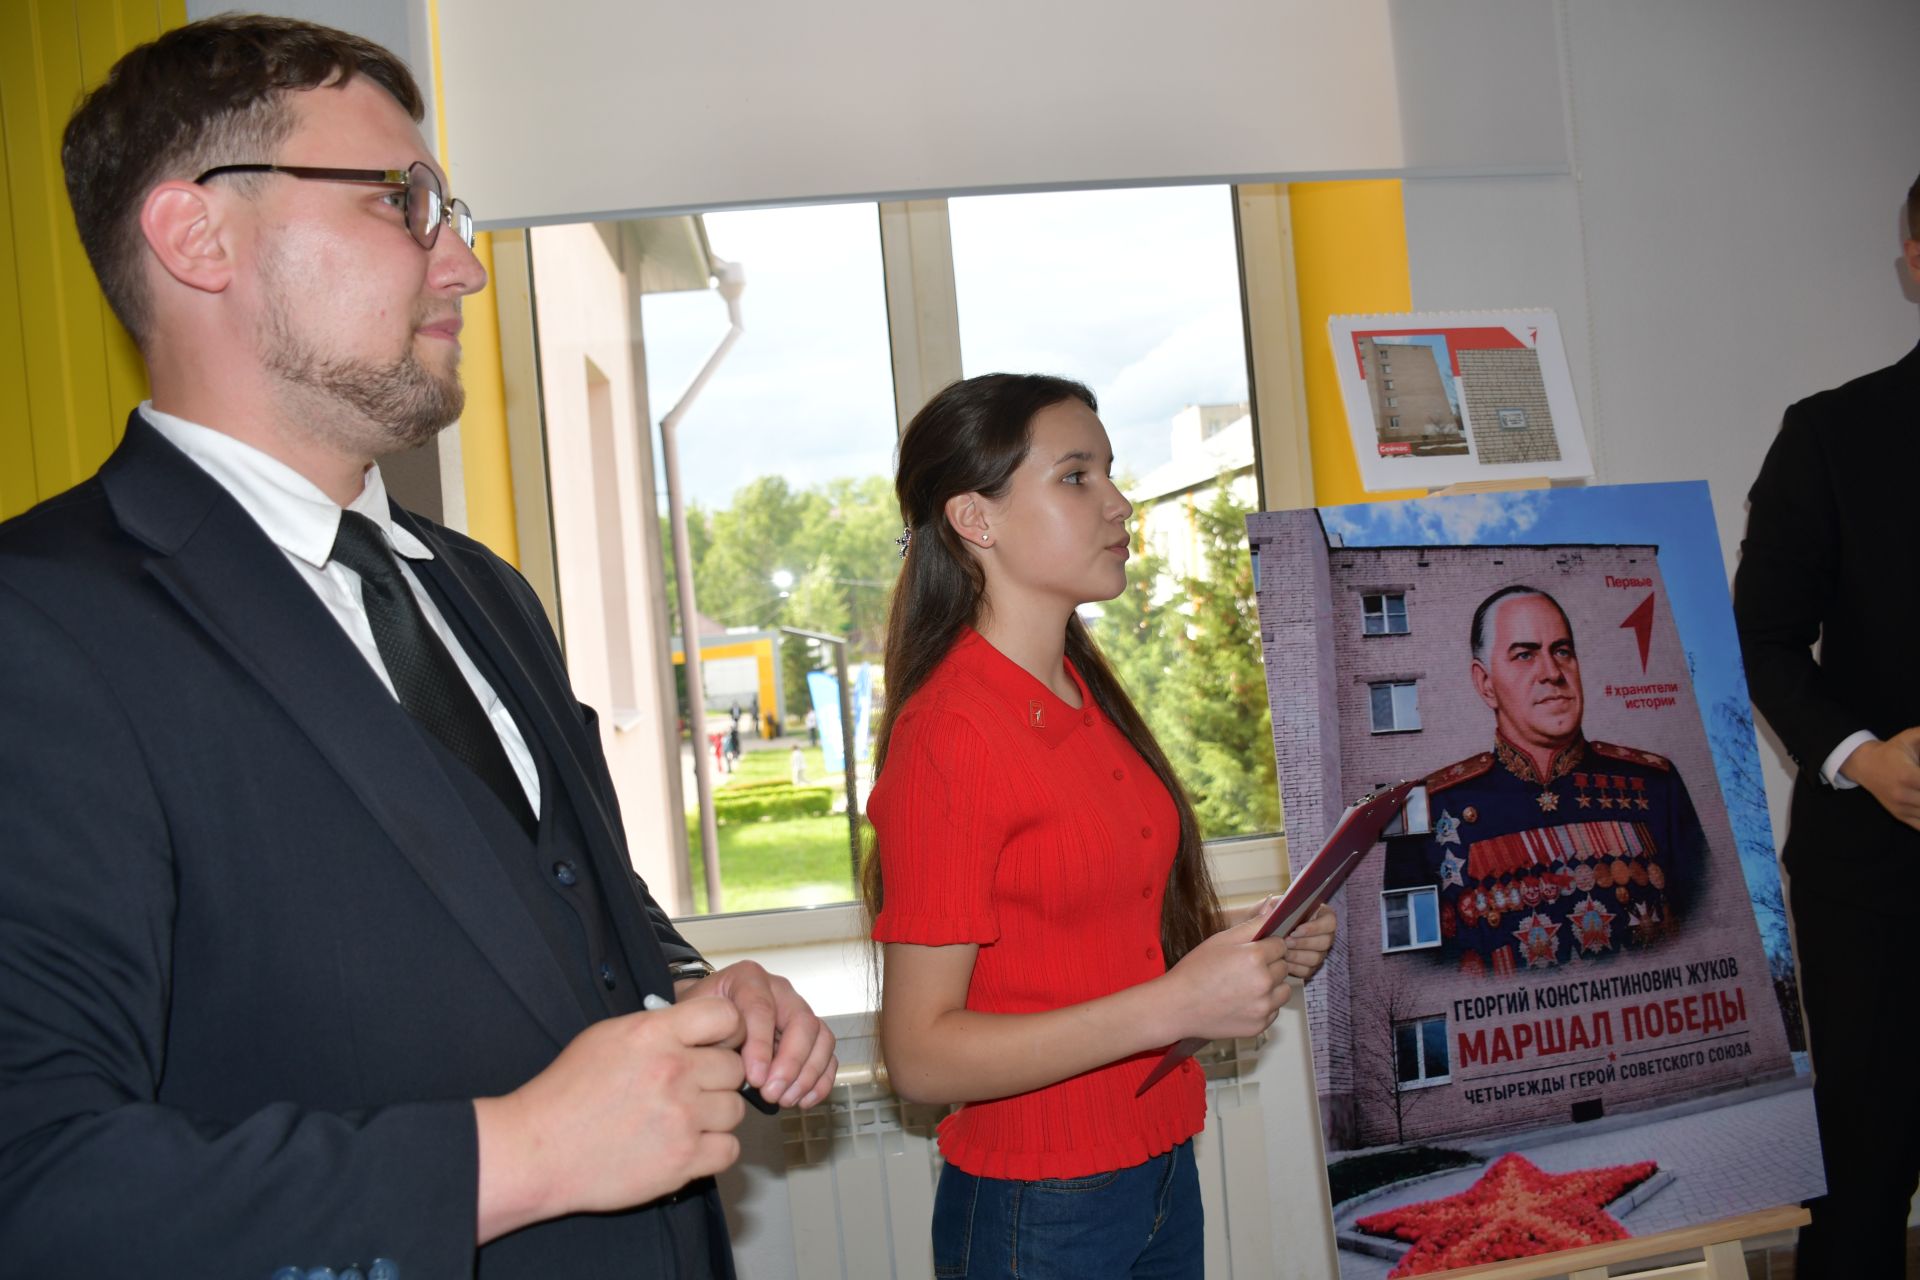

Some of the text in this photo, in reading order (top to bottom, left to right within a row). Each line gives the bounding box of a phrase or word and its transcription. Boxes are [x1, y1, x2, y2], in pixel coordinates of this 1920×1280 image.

[1605, 575, 1653, 590] Первые
[1625, 697, 1676, 711] истории
[1454, 957, 1739, 1022] ГЕОРГИЙ КОНСТАНТИНОВИЧ ЖУКОВ
[1458, 987, 1747, 1069] МАРШАЛ ПОБЕДЫ
[1464, 1042, 1752, 1105] ЧЕТЫРЕЖДЫ ГЕРОЙ СОВЕТСКОГО СОЮЗА
